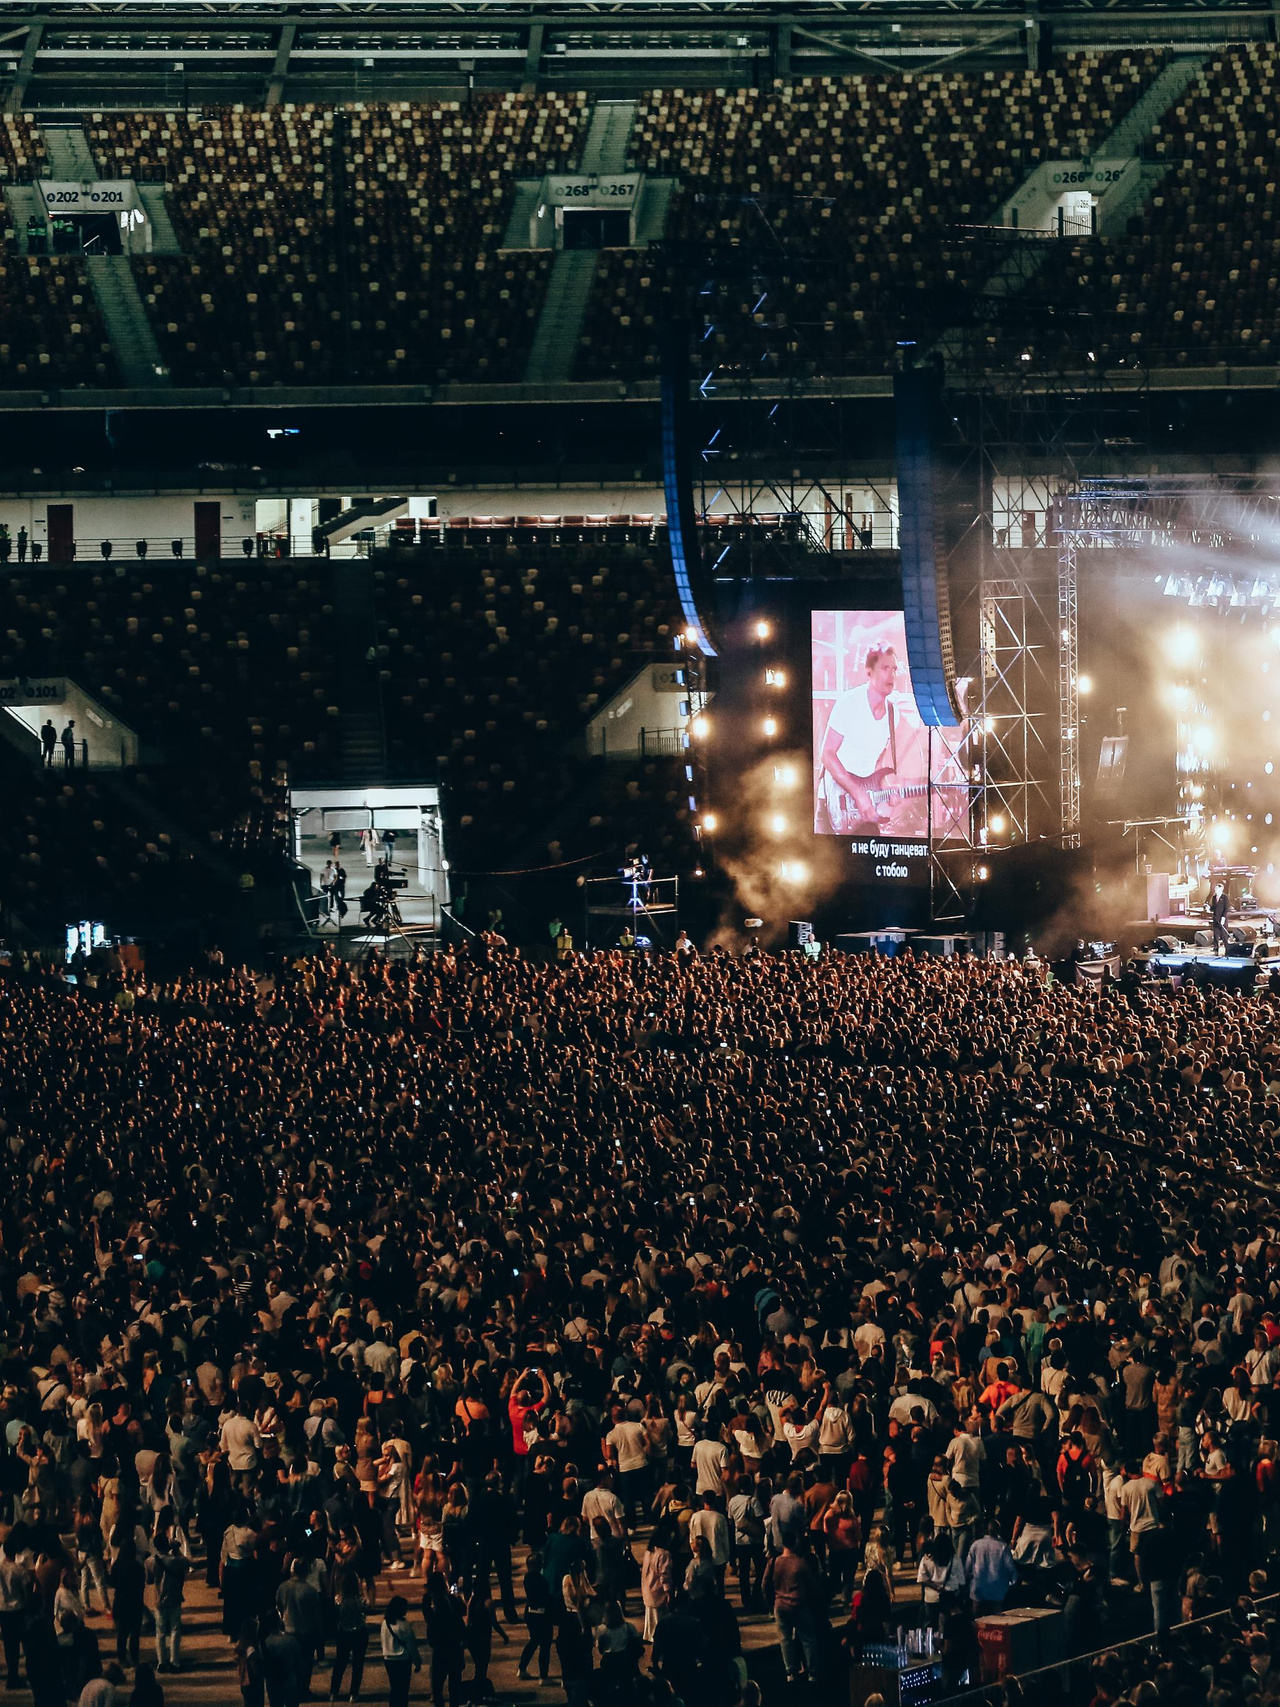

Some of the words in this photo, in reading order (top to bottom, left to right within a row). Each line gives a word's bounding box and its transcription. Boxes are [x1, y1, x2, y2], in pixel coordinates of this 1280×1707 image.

[1062, 172, 1085, 183] 266
[1105, 170, 1125, 181] 26
[56, 191, 79, 203] 202
[101, 191, 124, 202] 201
[565, 185, 589, 197] 268
[610, 184, 634, 196] 267
[0, 687, 15, 699] 02
[36, 686, 58, 698] 101
[851, 842, 857, 854] я
[859, 842, 869, 855] не
[870, 839, 890, 858] буду
[891, 842, 929, 858] танцеват
[875, 864, 881, 877] с
[882, 862, 908, 878] тобою
